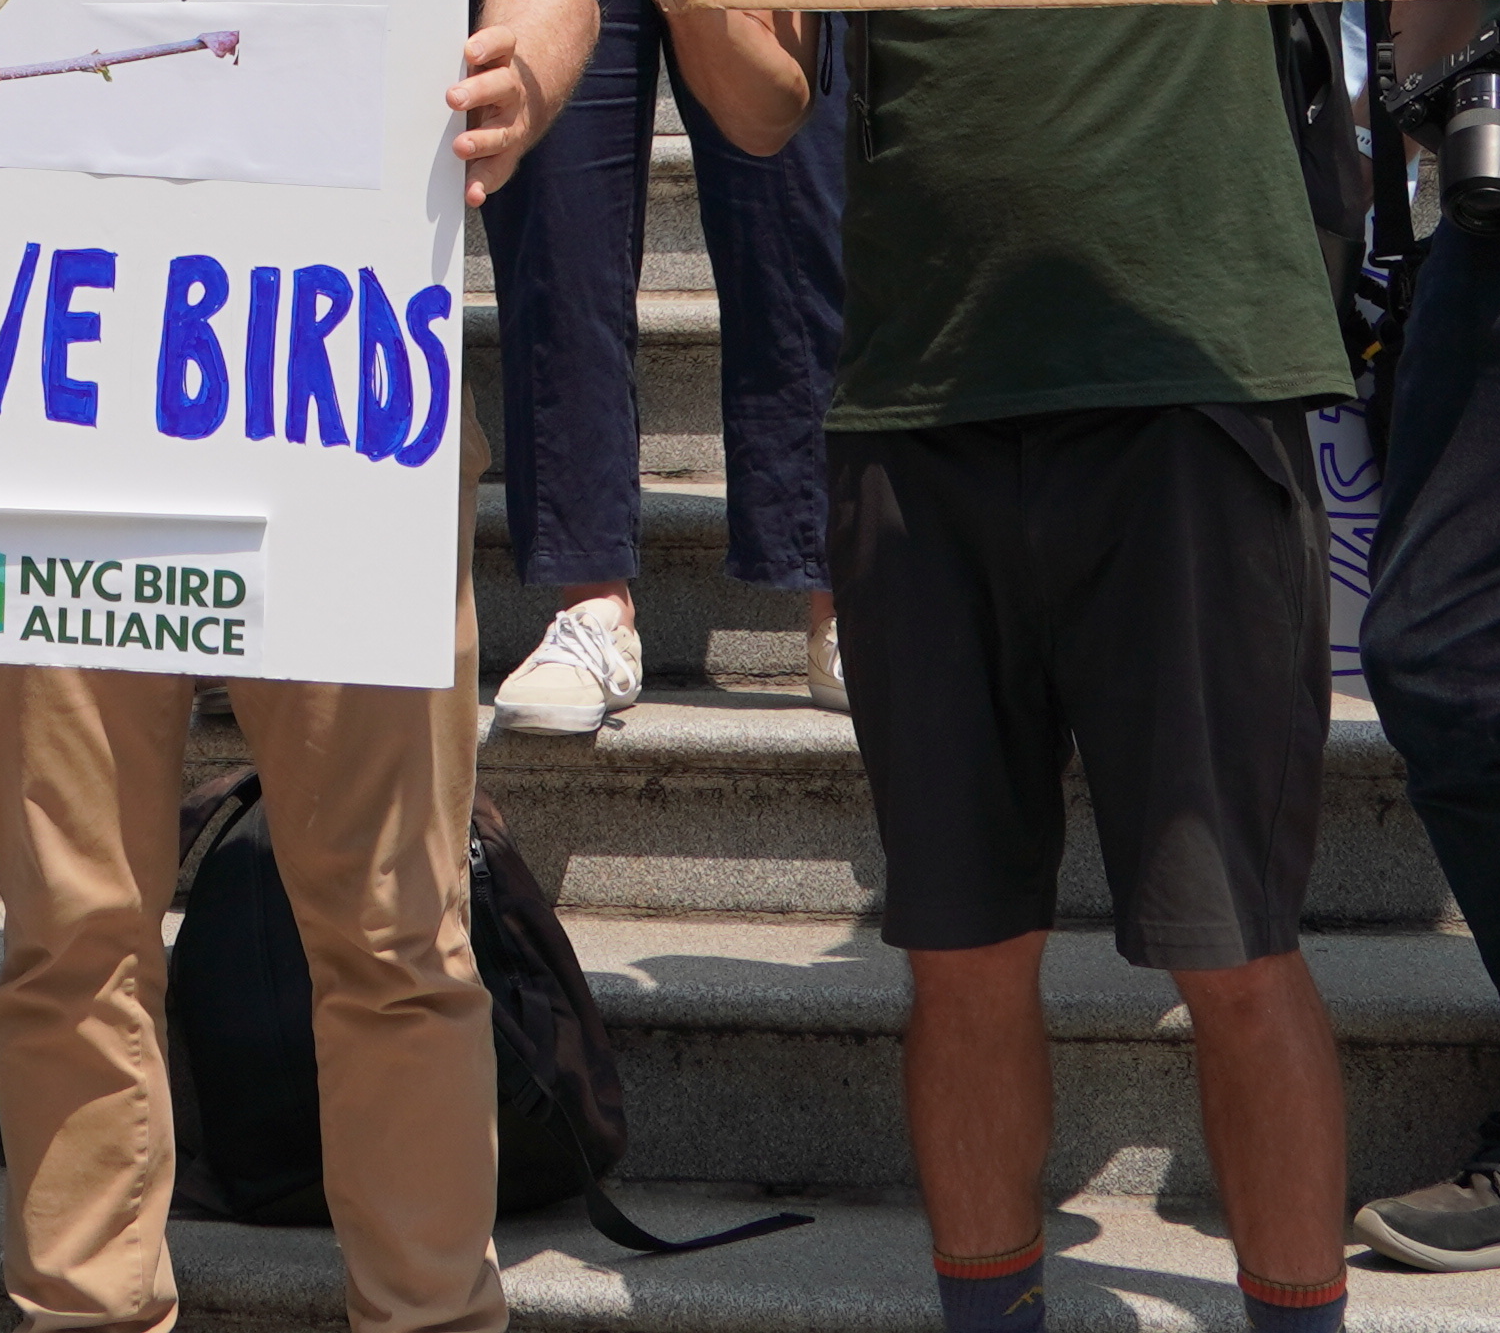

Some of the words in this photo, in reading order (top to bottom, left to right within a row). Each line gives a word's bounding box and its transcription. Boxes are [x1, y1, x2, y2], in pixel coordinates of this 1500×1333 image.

[156, 254, 452, 469] BIRDS
[20, 555, 122, 603] NYC
[135, 562, 246, 610] BIRD
[20, 606, 246, 656] ALLIANCE
